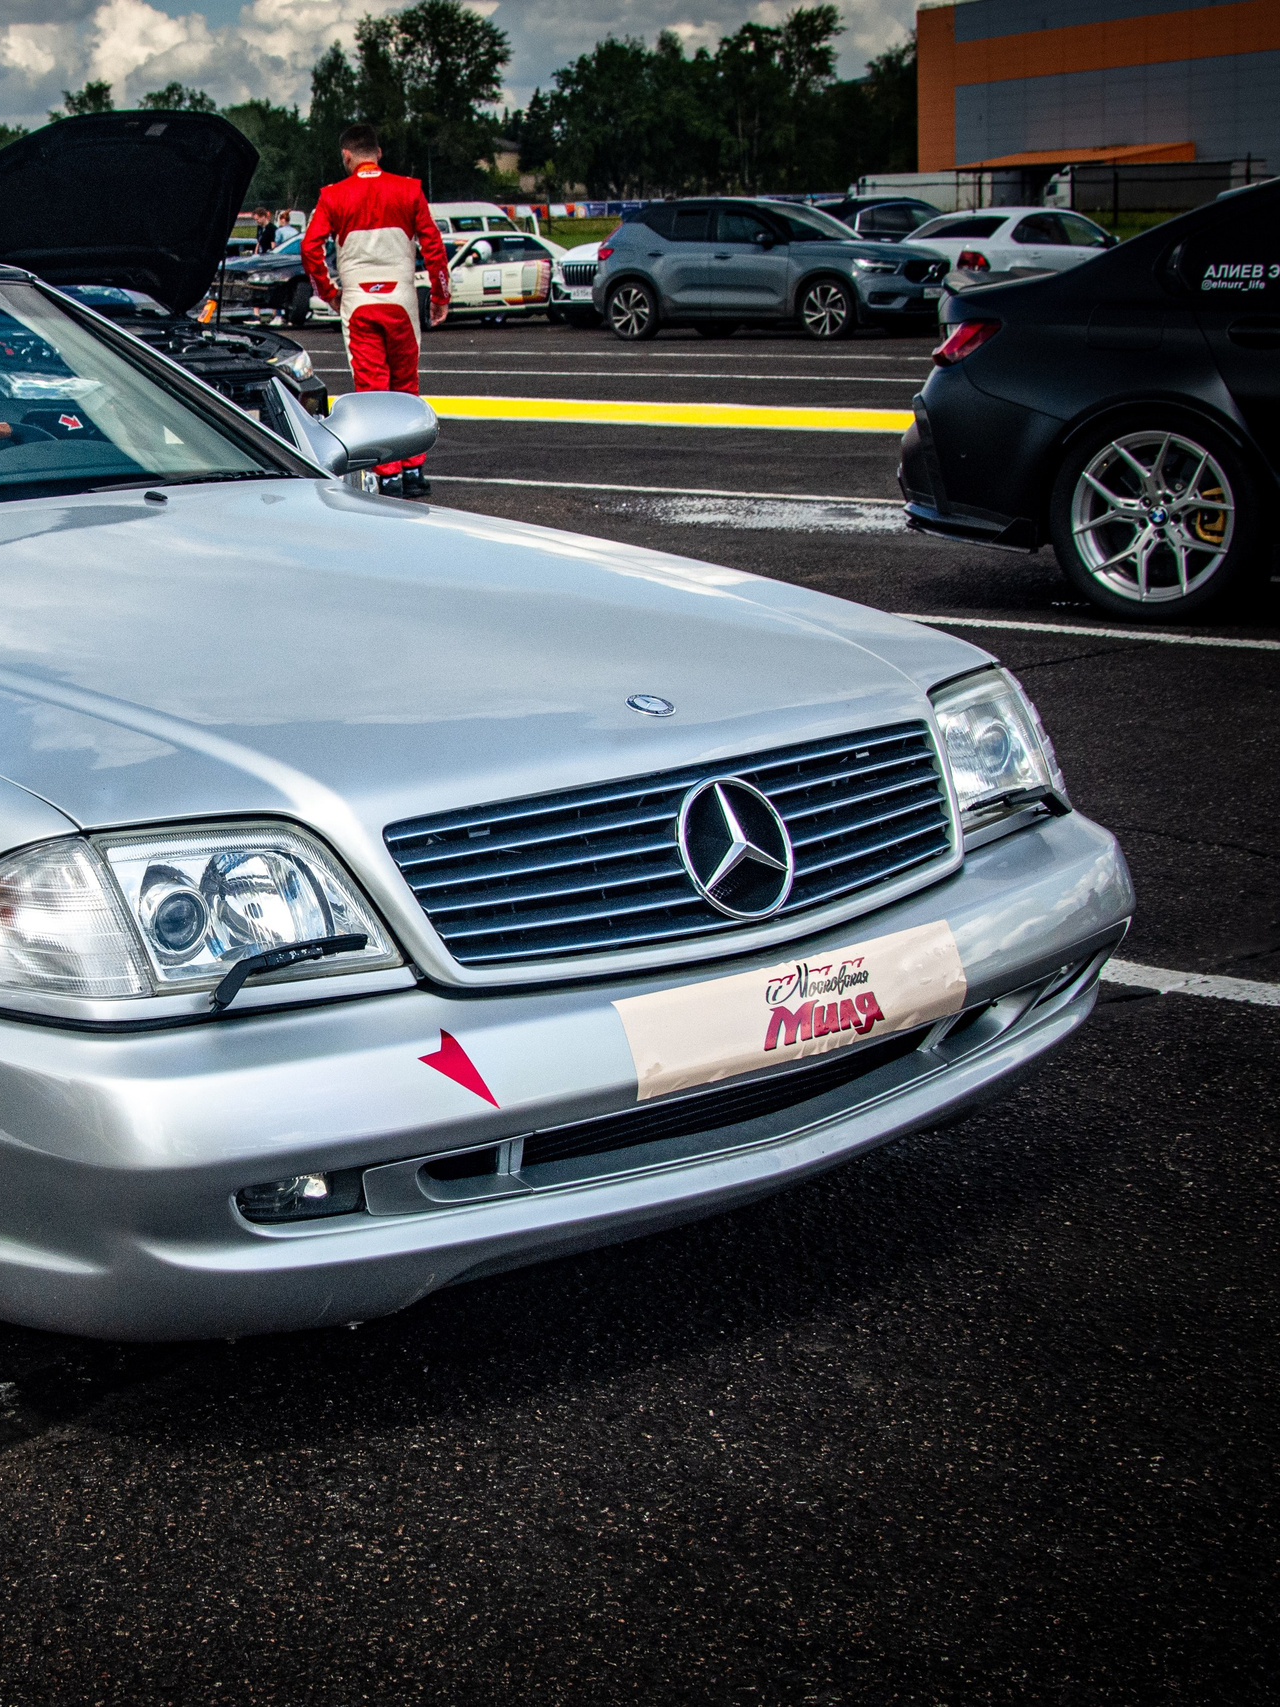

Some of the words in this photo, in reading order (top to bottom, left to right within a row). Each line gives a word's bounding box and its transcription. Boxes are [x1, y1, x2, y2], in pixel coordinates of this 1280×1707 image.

[1204, 264, 1264, 279] АЛИЕВ
[765, 962, 870, 1006] Московская
[763, 990, 886, 1052] Миля
